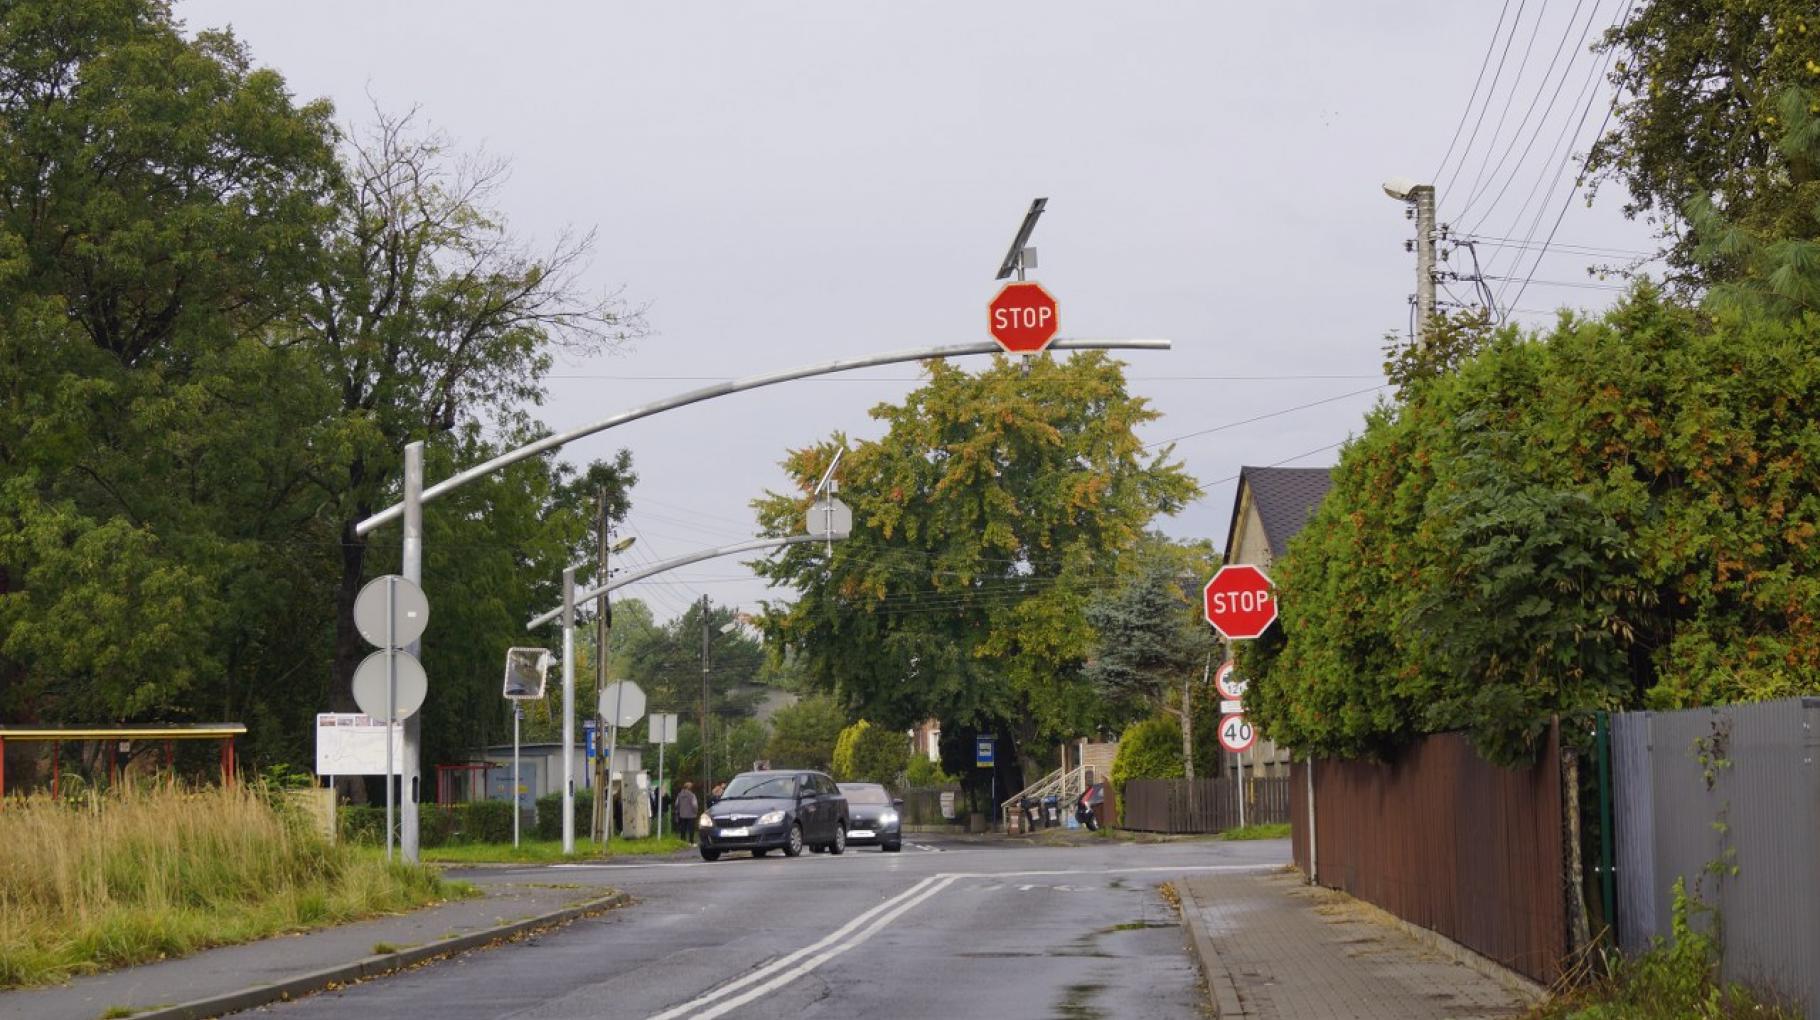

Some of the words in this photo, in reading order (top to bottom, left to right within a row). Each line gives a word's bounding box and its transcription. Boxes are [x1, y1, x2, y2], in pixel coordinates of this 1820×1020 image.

[995, 306, 1051, 329] STOP
[1213, 590, 1269, 614] STOP
[1224, 724, 1251, 741] 40
